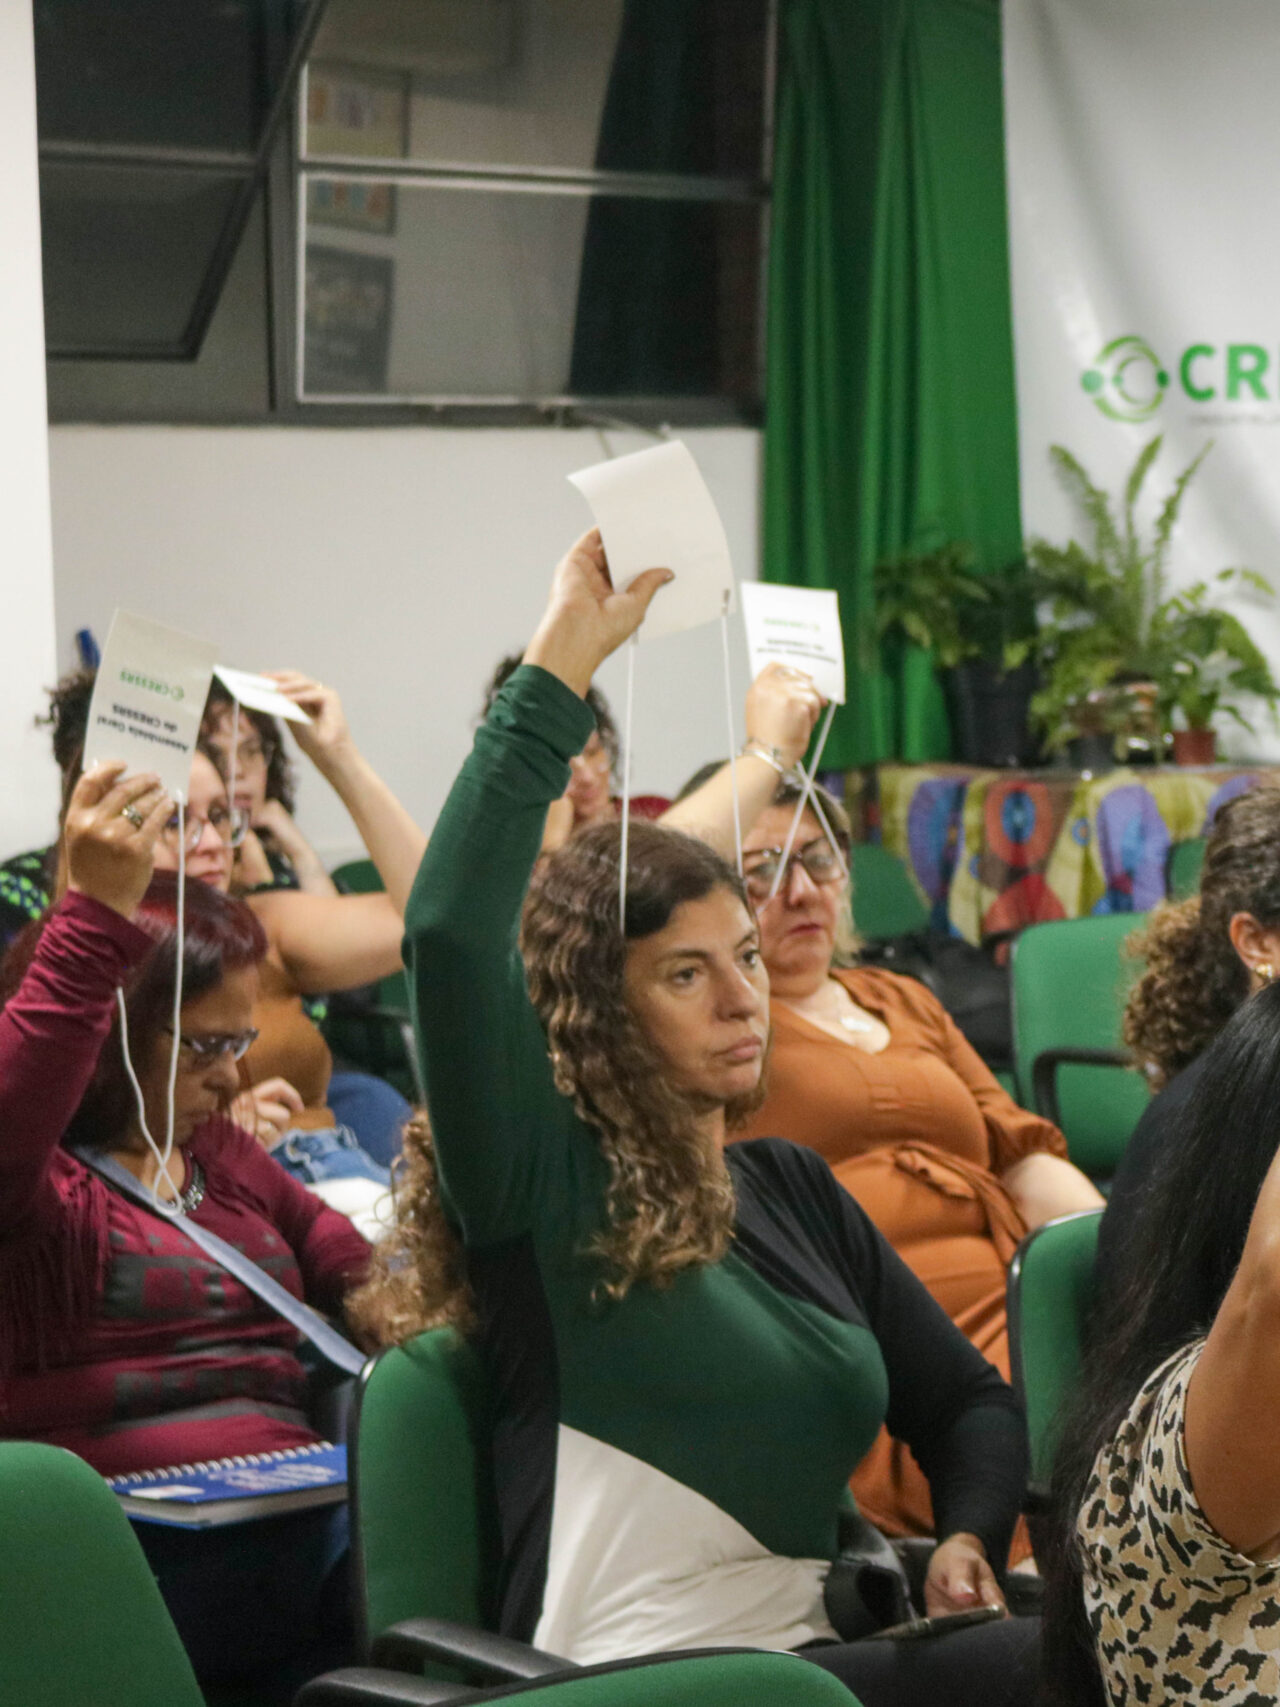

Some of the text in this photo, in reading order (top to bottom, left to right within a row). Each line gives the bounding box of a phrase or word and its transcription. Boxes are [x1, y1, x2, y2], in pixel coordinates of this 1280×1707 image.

[119, 670, 170, 696] CRESSRS
[96, 715, 126, 733] Geral
[112, 702, 161, 729] CRESSRS
